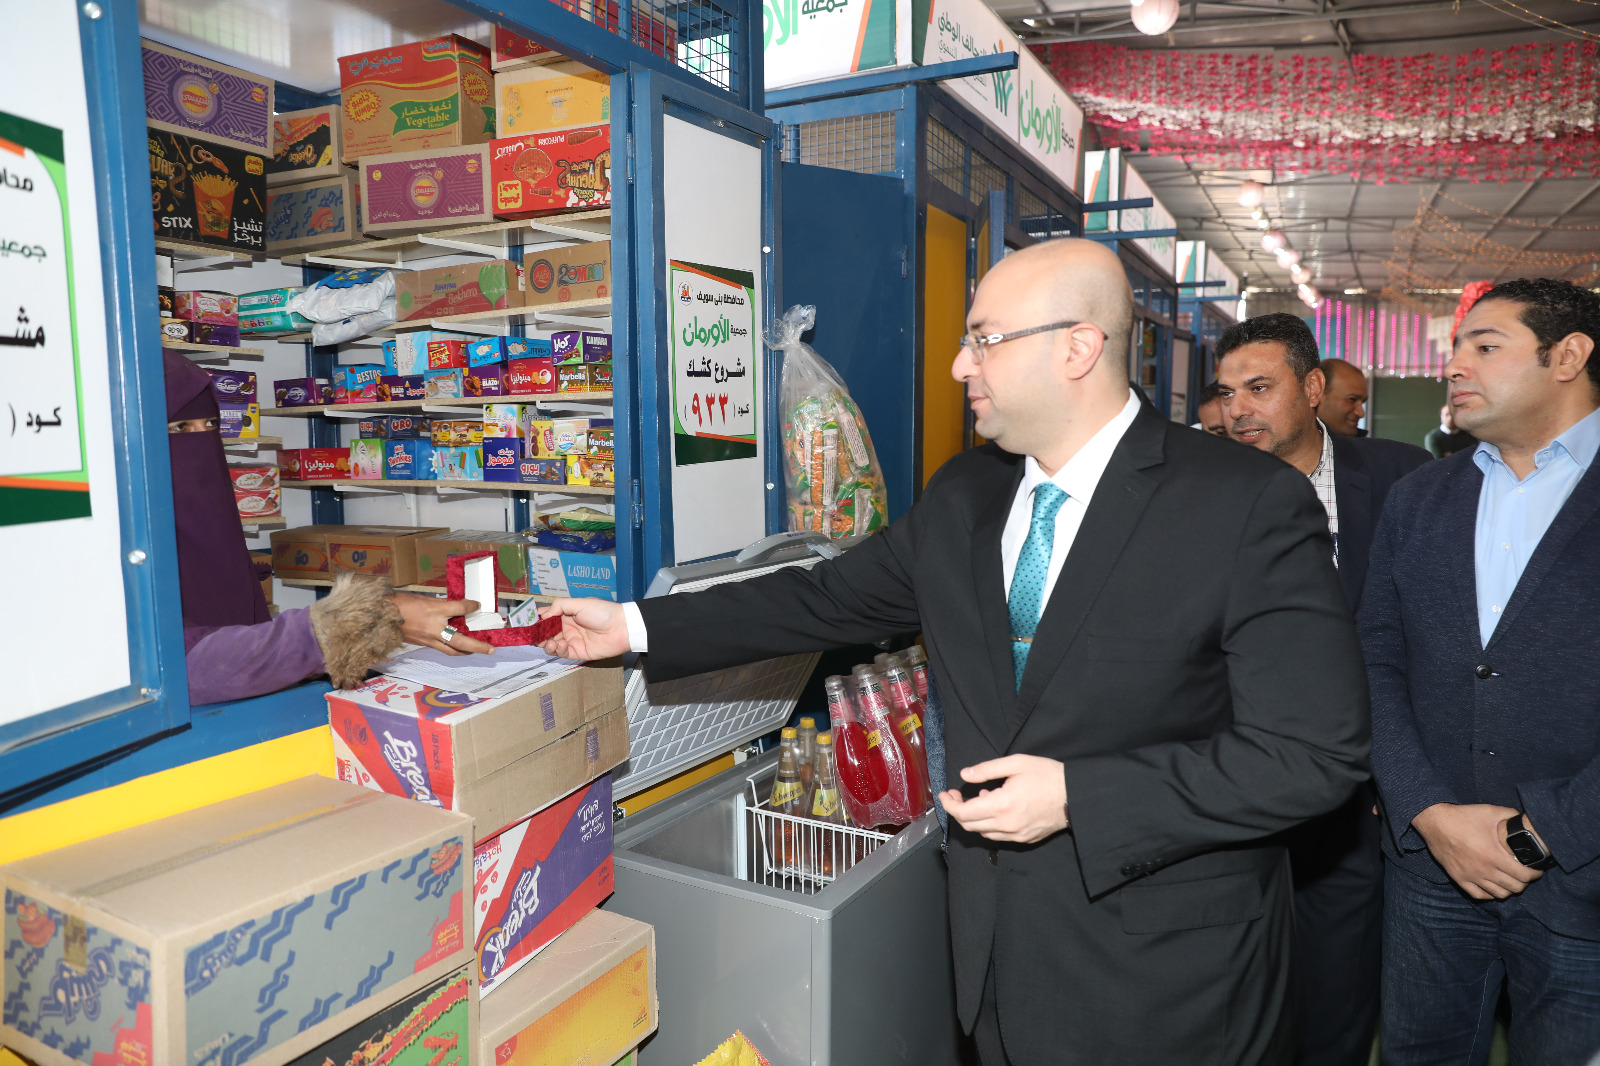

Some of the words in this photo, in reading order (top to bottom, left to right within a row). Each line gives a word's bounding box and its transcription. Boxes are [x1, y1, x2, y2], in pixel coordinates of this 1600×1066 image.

[937, 11, 961, 42] الوطني
[351, 94, 370, 108] جامبو
[428, 100, 452, 112] نكهة
[354, 101, 377, 119] JUMBO
[401, 106, 427, 119] خضار
[1019, 79, 1061, 155] الأورمان
[405, 112, 450, 128] Vegetable
[538, 135, 566, 146] PUFFCORN
[162, 216, 193, 229] STIX
[233, 217, 263, 233] تشيز
[233, 230, 262, 247] برجر
[433, 282, 457, 292] JUHAYNA
[447, 287, 478, 305] Bekhero
[696, 290, 714, 304] سويف
[723, 293, 745, 306] محافظة
[682, 313, 730, 348] الأورمان
[730, 324, 748, 338] جمعية
[686, 356, 712, 378] كشك
[714, 357, 746, 384] مشروع
[356, 369, 382, 385] BESTOS
[559, 372, 586, 381] Marbella
[737, 403, 750, 417] كود
[391, 418, 412, 430] URO
[394, 443, 404, 453] Mini
[388, 450, 412, 468] Twinkies
[567, 564, 591, 579] LASHO
[591, 566, 611, 580] LAND
[432, 743, 442, 771] Packs
[483, 865, 543, 979] Break
